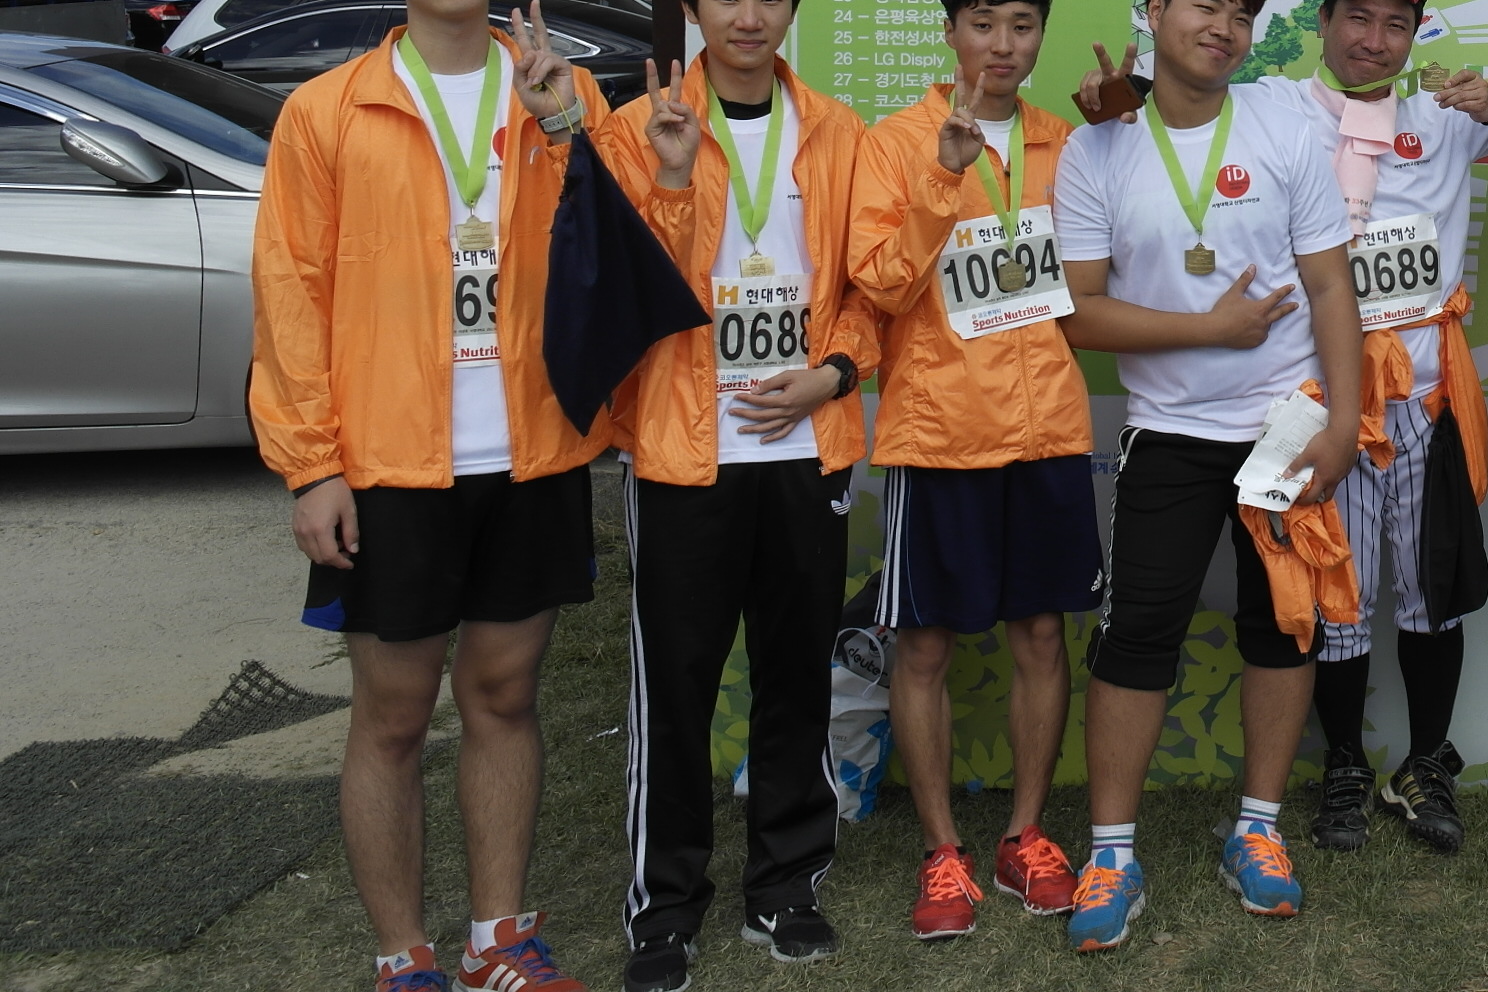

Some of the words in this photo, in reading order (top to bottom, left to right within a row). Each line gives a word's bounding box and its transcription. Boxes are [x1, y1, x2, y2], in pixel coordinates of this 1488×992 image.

[834, 10, 853, 23] 24
[834, 31, 852, 44] 25
[834, 52, 852, 65] 26
[875, 53, 895, 66] LG
[901, 53, 945, 68] Disply
[834, 73, 852, 86] 27
[875, 73, 934, 88] 경기도청
[875, 94, 925, 107] 코스모
[1363, 226, 1416, 247] 현대해상
[1350, 244, 1439, 298] 0689
[746, 286, 799, 305] 현대해상
[972, 315, 1004, 329] Sports
[1004, 304, 1051, 322] Nutrition
[1384, 306, 1426, 320] Nutrition
[848, 648, 888, 677] deuter
